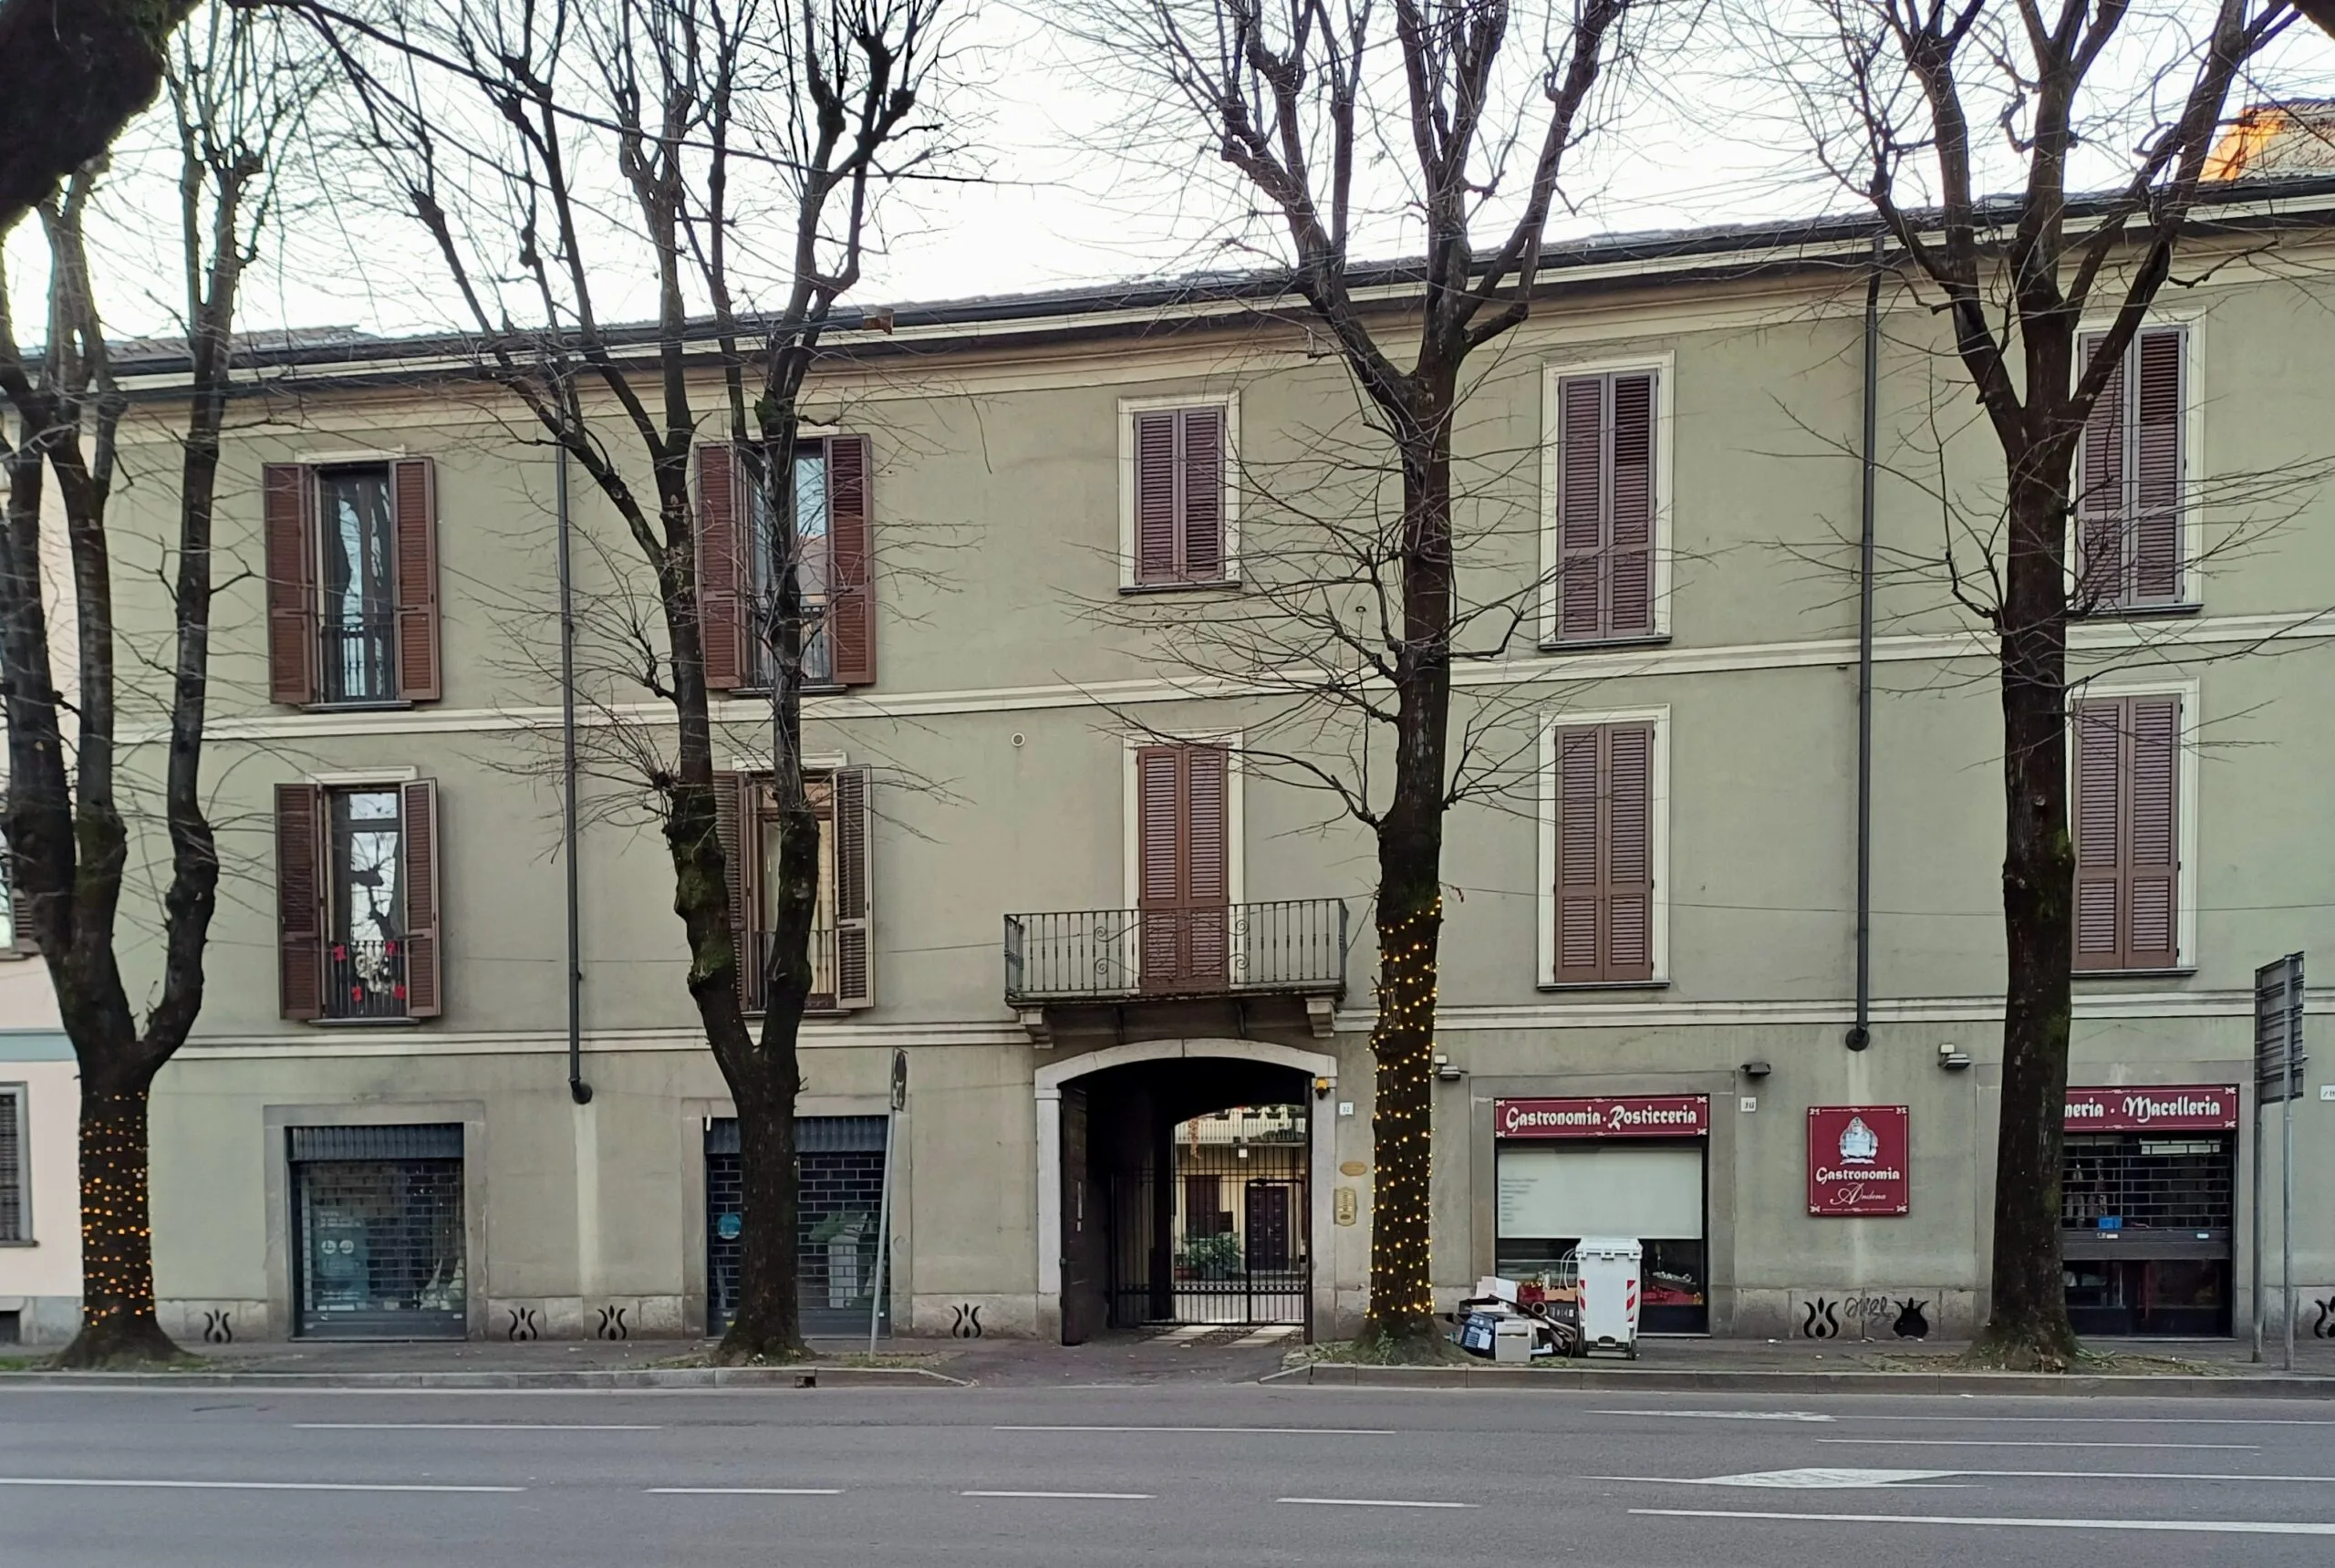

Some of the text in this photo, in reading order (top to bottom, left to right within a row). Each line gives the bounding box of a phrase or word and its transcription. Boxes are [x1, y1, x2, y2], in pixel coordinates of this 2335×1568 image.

[1506, 1105, 1697, 1132] Gastronomia Rosticceria
[2122, 1096, 2220, 1123] Macelleria
[1815, 1166, 1900, 1185] Gastronomia
[1830, 1182, 1886, 1205] Andena
